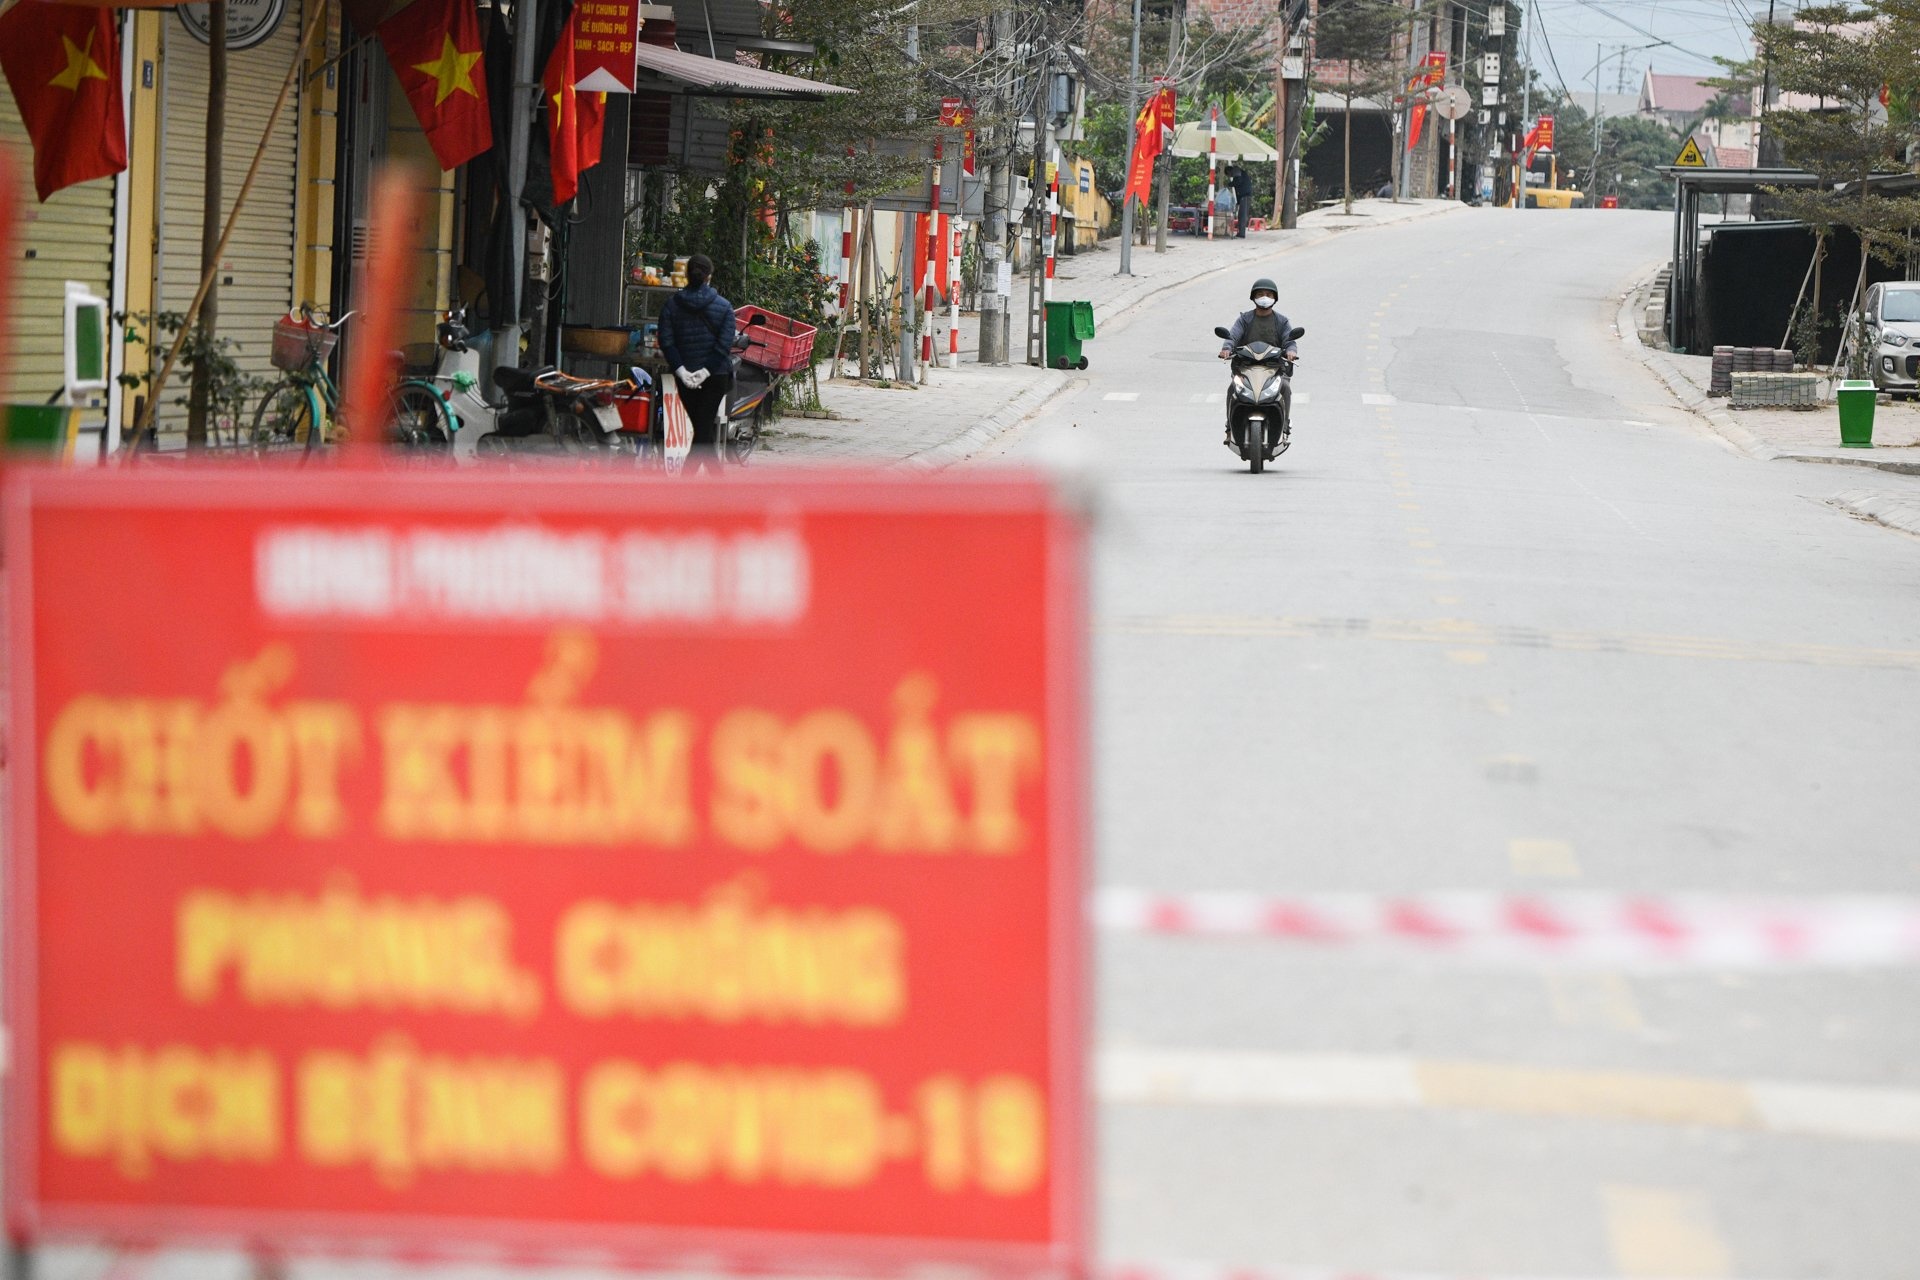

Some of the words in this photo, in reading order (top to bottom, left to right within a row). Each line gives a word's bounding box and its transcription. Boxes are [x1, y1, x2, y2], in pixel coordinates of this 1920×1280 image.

[575, 39, 592, 51] XANH
[597, 40, 615, 54] SẠCH
[620, 42, 633, 56] ĐẸP
[596, 4, 617, 16] CHUNG
[619, 5, 629, 16] TAY
[614, 20, 628, 35] PHỐ
[43, 642, 362, 840] CHỐT
[376, 624, 699, 847] KIỂM
[707, 670, 1042, 855] SOÁT
[174, 869, 542, 1025] PHÒNG,
[554, 869, 908, 1027] CHỐNG
[48, 1038, 283, 1181] DỊCH
[296, 1030, 567, 1191] BỆNH
[579, 1056, 1048, 1194] COVID-19
